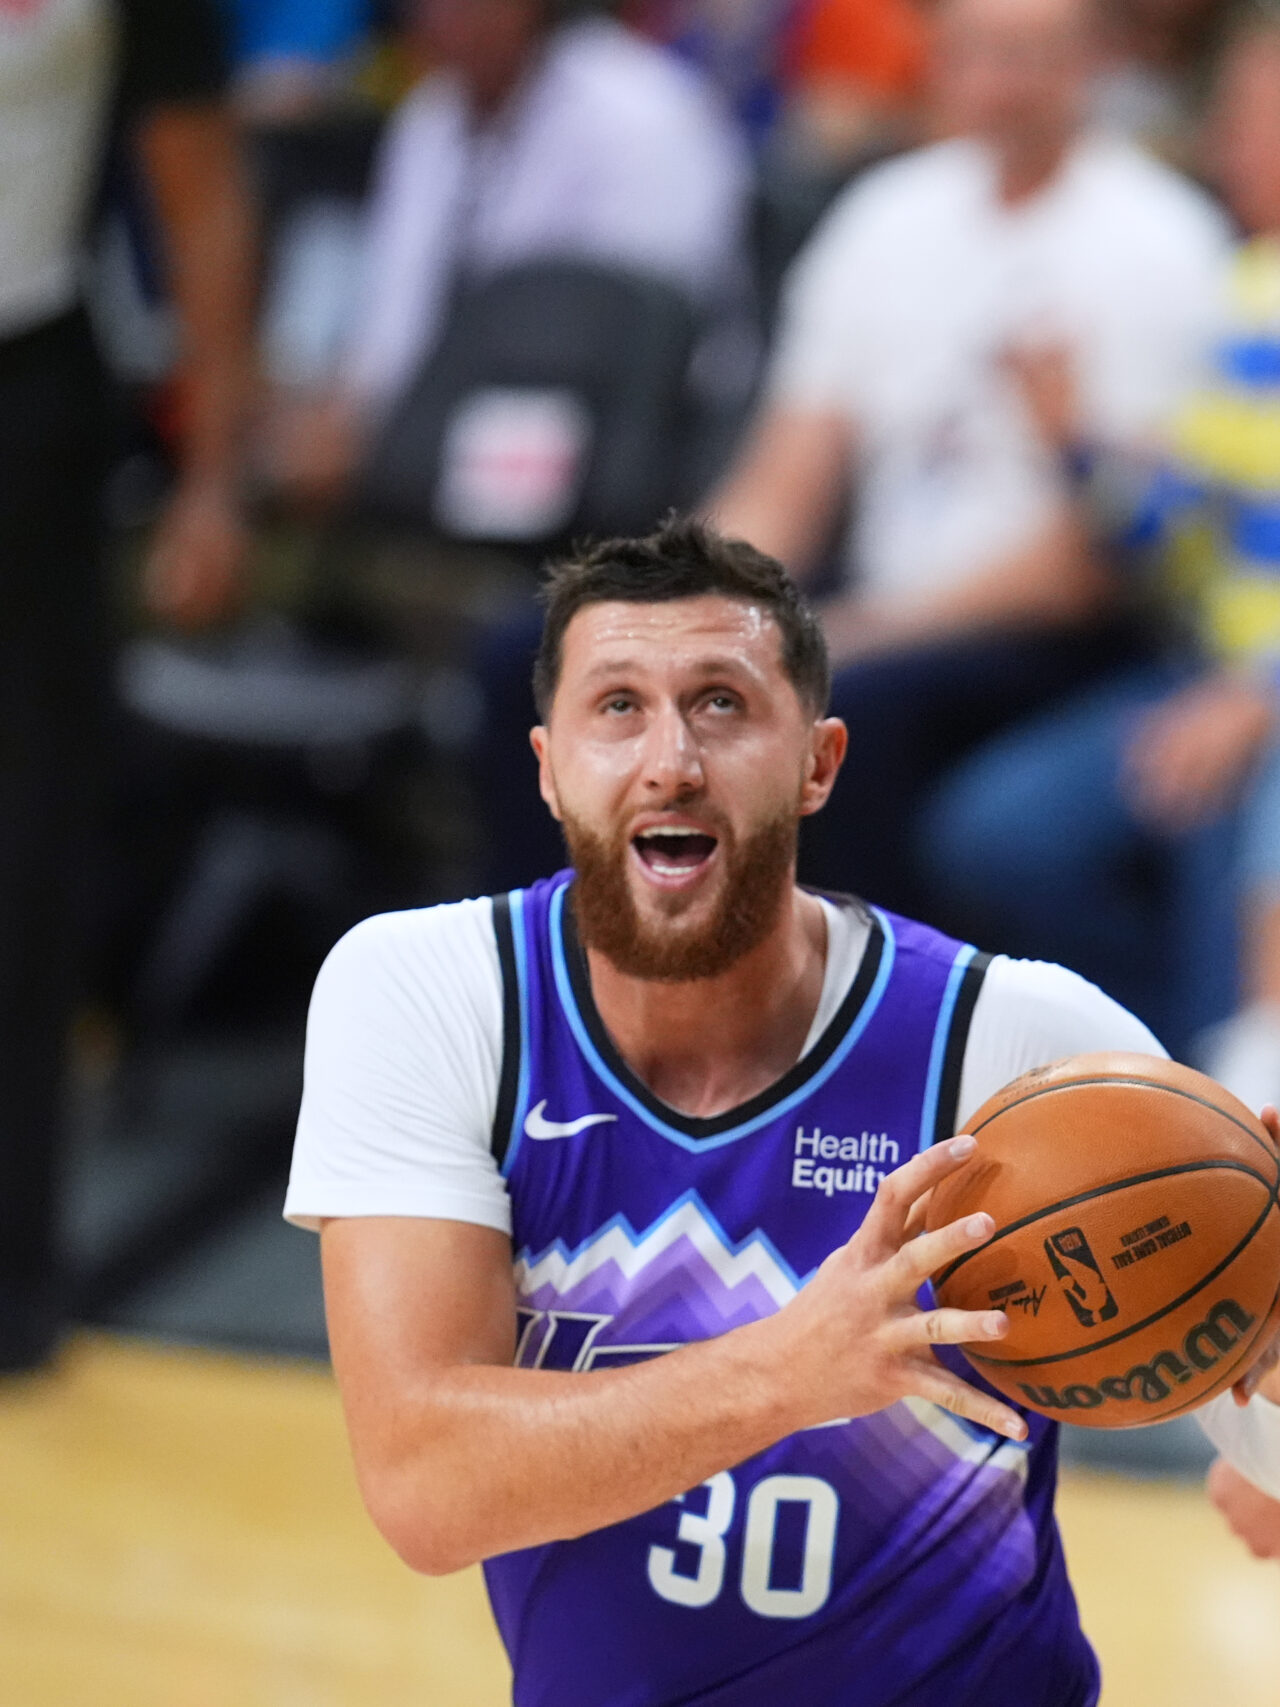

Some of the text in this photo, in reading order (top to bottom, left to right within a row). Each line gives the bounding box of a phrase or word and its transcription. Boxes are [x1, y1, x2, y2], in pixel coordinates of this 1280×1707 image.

[794, 1126, 900, 1164] Health
[1057, 1232, 1083, 1252] NBA
[1019, 1297, 1256, 1411] Wilson
[647, 1469, 839, 1620] 30
